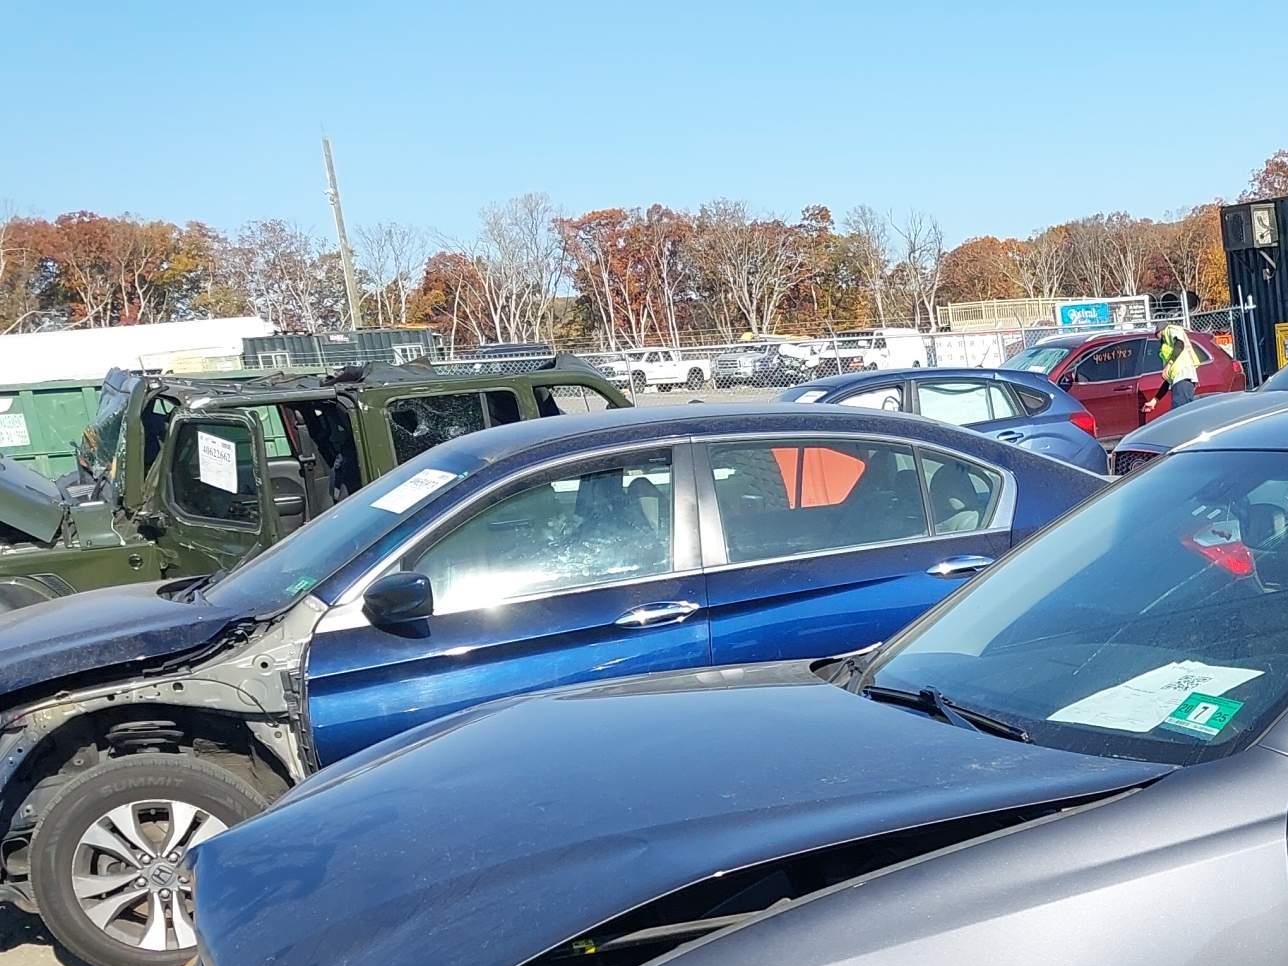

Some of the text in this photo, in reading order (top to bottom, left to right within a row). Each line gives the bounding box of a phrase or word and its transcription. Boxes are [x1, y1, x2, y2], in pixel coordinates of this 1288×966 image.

[1176, 703, 1229, 723] 20 7 25
[101, 776, 183, 796] SUMMIT
